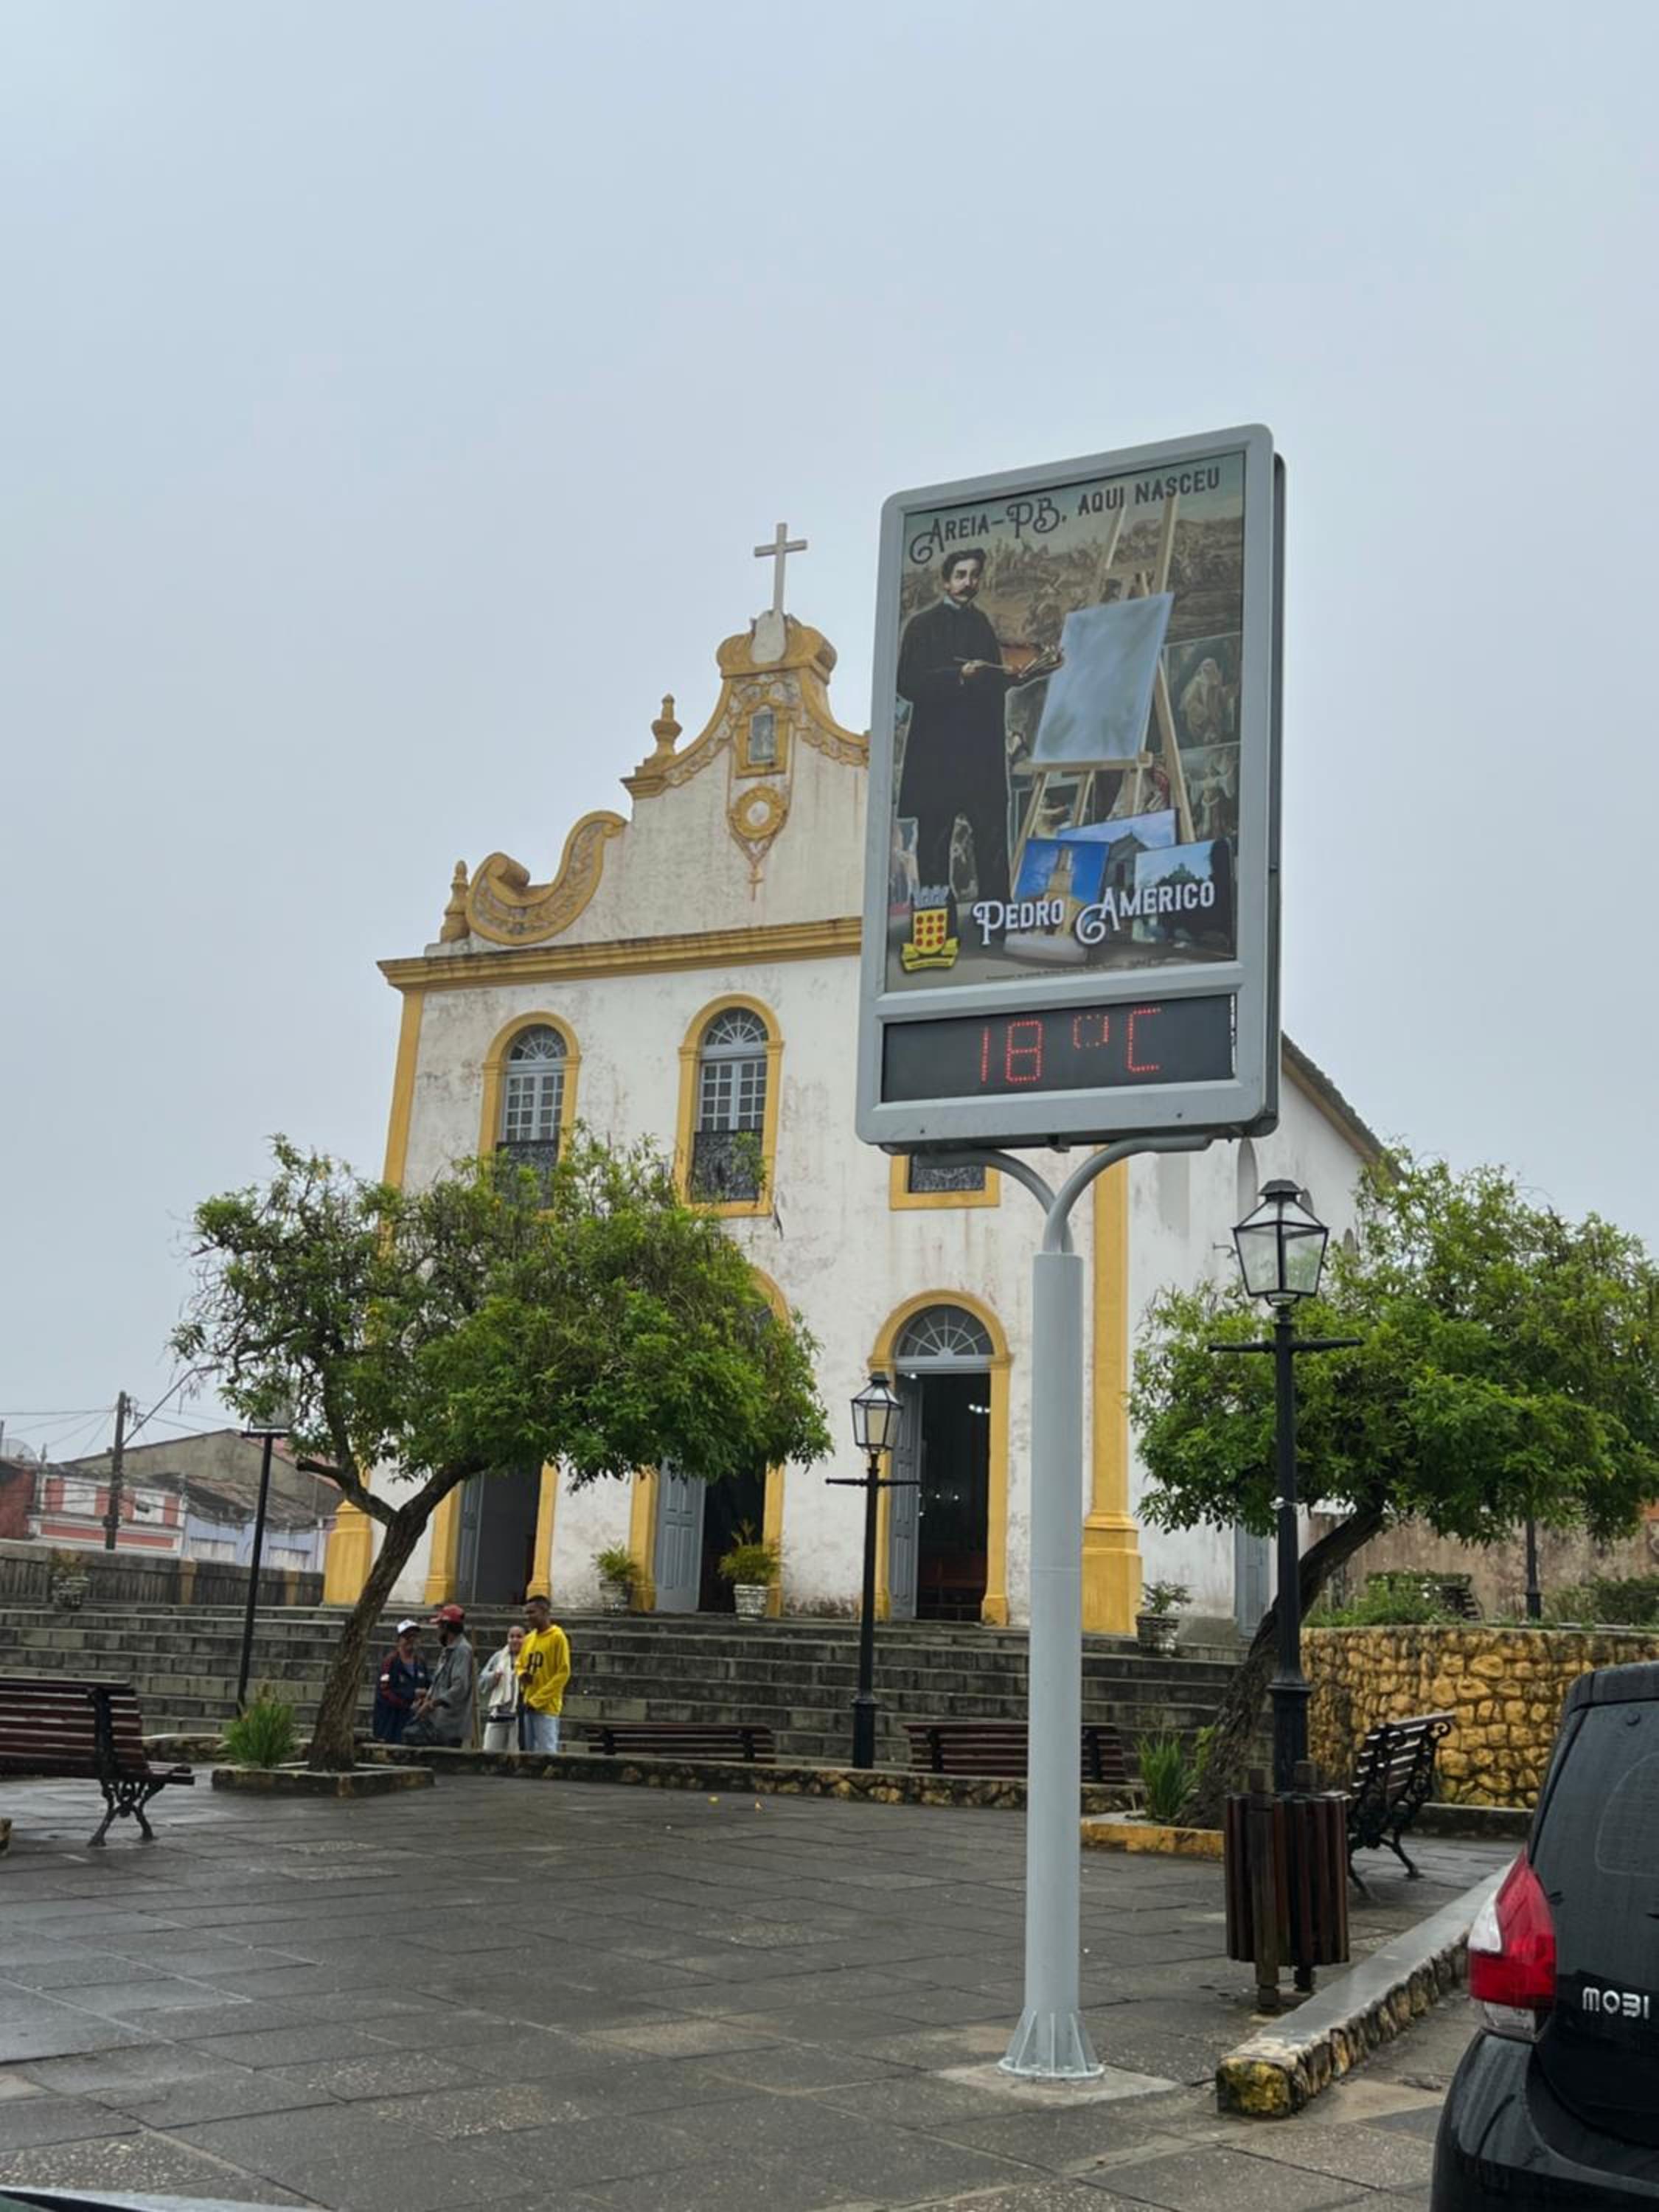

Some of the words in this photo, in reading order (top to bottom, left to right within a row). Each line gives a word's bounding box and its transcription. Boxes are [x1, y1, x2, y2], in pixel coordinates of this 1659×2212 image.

[1078, 486, 1124, 516] AQUI
[1135, 467, 1220, 505] NASCEU
[973, 899, 1064, 946] PEDRO
[981, 1020, 1043, 1084] 18
[1582, 1986, 1649, 2020] MOBI
